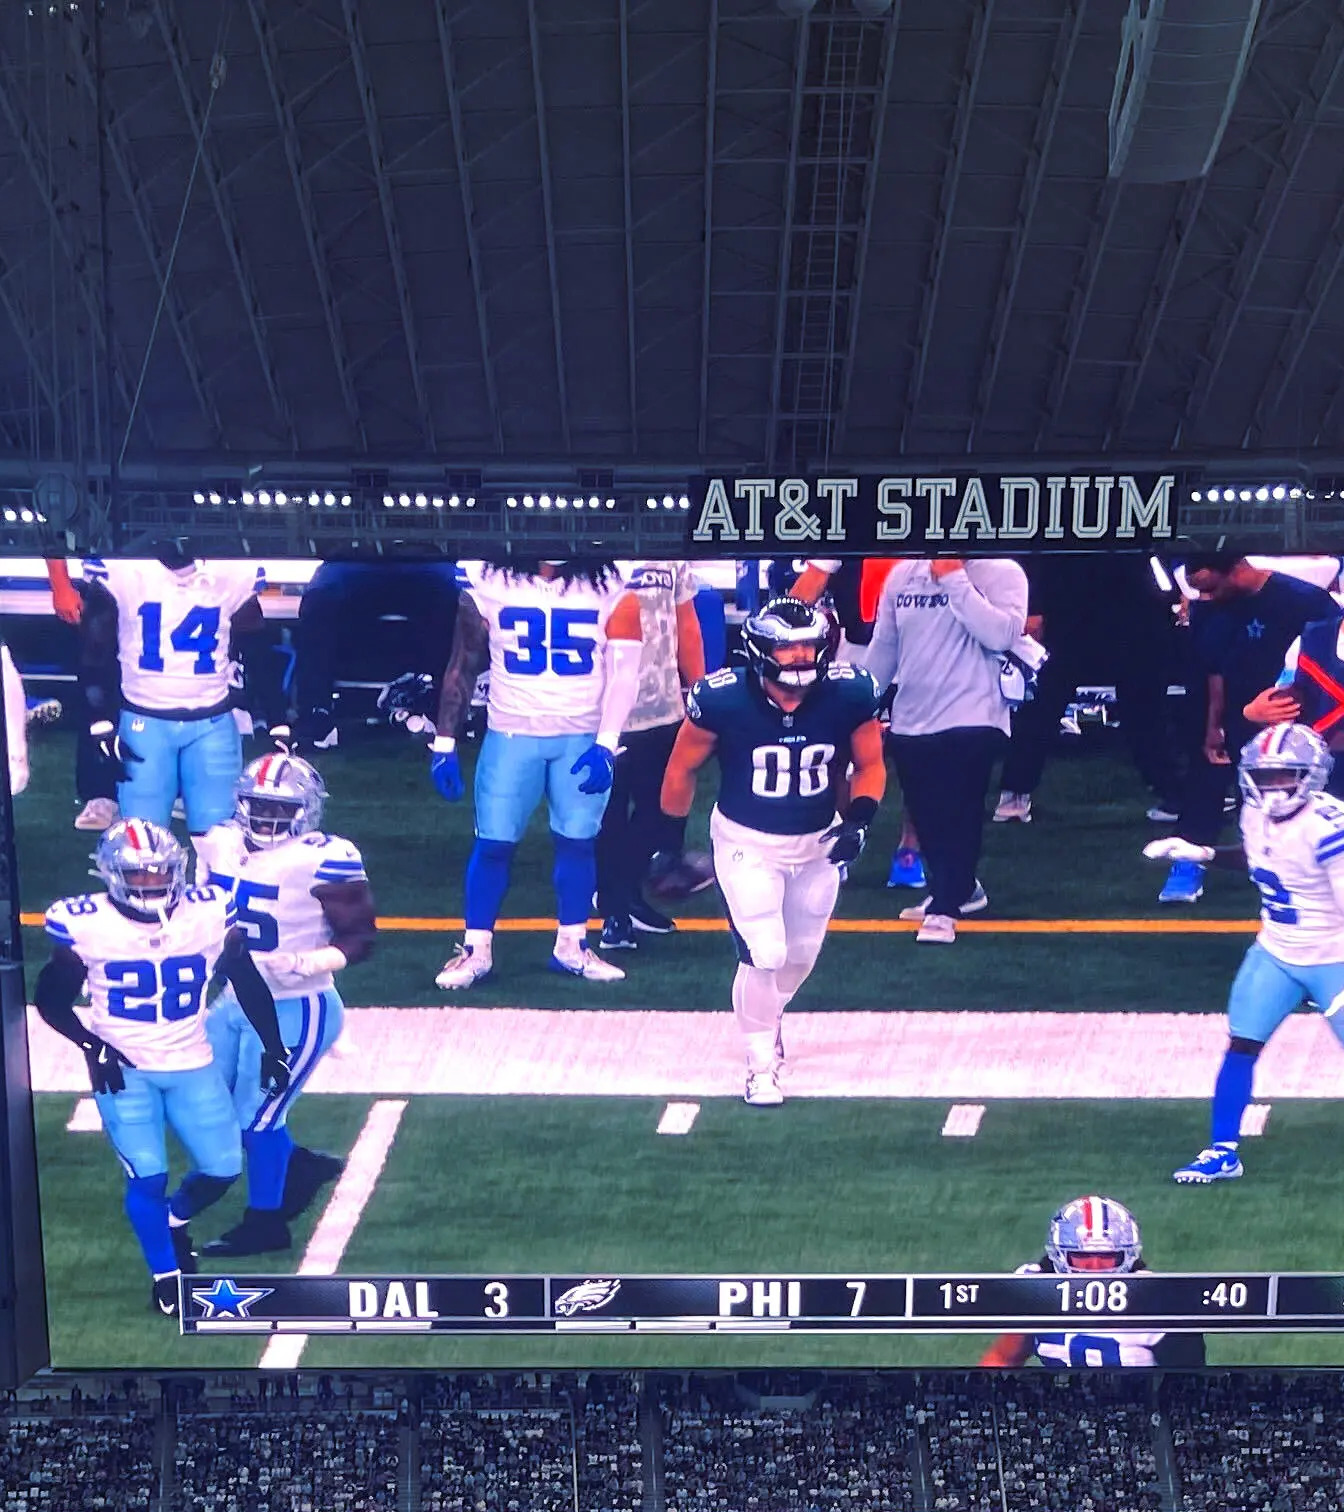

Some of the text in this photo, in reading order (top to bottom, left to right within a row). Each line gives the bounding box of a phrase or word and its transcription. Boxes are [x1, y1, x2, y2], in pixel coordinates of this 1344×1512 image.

[692, 475, 1174, 542] AT&T STADIUM
[138, 602, 221, 673] 14
[498, 606, 599, 676] 35
[207, 871, 280, 952] 5
[103, 953, 208, 1024] 28
[349, 1281, 509, 1319] DAL 3
[719, 1280, 867, 1318] PHI 7
[939, 1280, 1248, 1313] 1ST 1:08 :40
